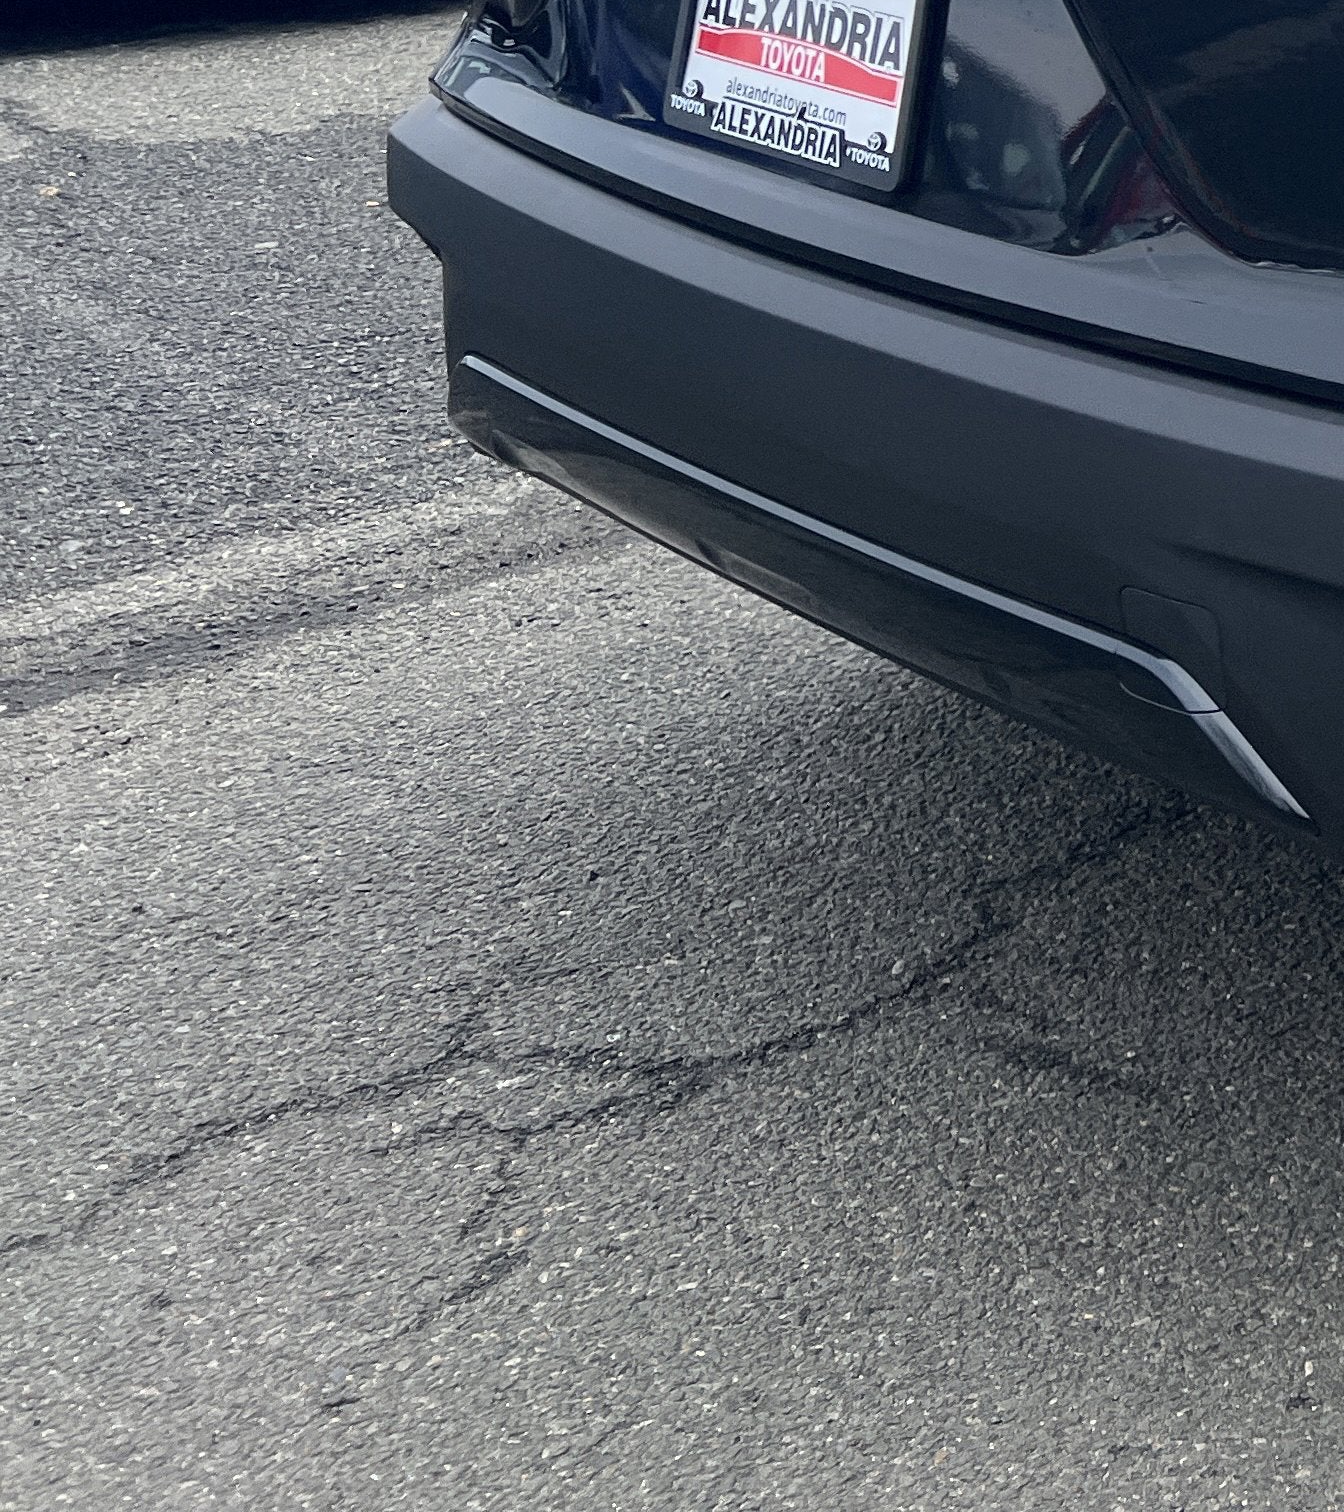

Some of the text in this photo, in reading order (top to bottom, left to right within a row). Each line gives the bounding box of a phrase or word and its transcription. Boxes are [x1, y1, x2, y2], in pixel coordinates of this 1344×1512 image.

[760, 37, 826, 84] TOYOTA
[670, 95, 705, 117] TOYOTA
[712, 101, 840, 165] ALEXANDRIA
[850, 148, 891, 172] TOYOTA
